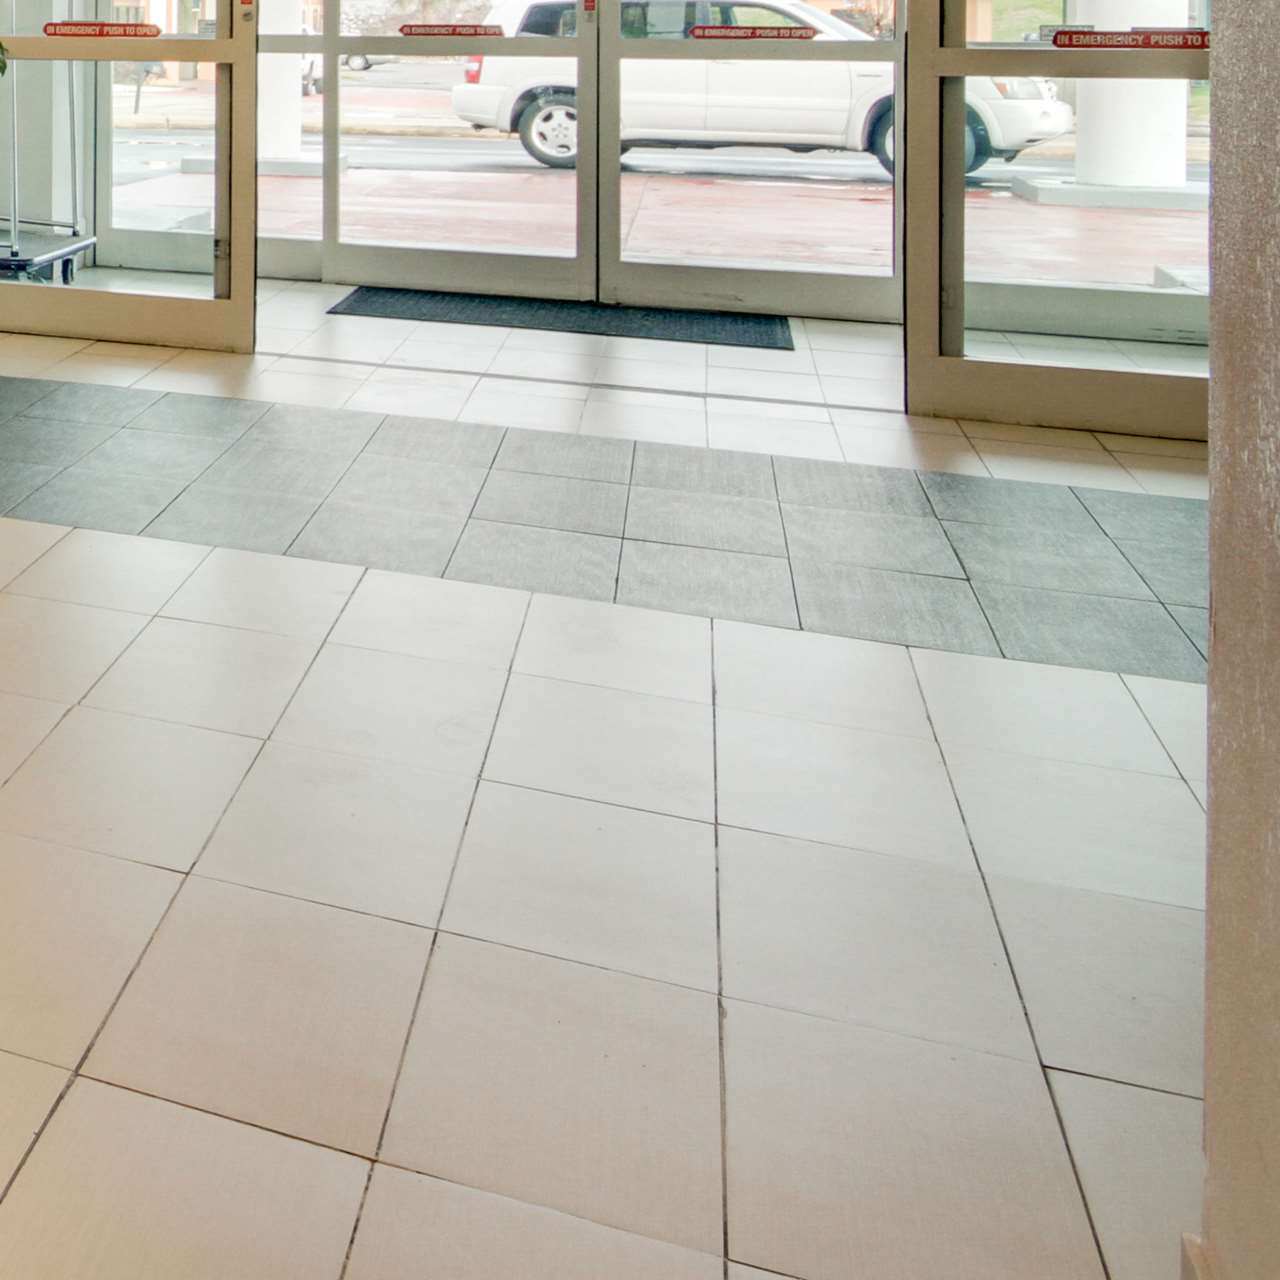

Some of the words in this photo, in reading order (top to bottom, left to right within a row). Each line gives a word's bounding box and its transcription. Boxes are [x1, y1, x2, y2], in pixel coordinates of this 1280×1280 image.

[56, 26, 99, 36] EMERGENCY
[104, 26, 124, 36] PUSH
[704, 28, 753, 38] EMERGENCY
[755, 28, 778, 38] PUSH
[1056, 34, 1069, 45] IN
[1072, 34, 1143, 45] EMERGENCY
[1151, 34, 1184, 45] PUSH
[1186, 35, 1201, 45] TO
